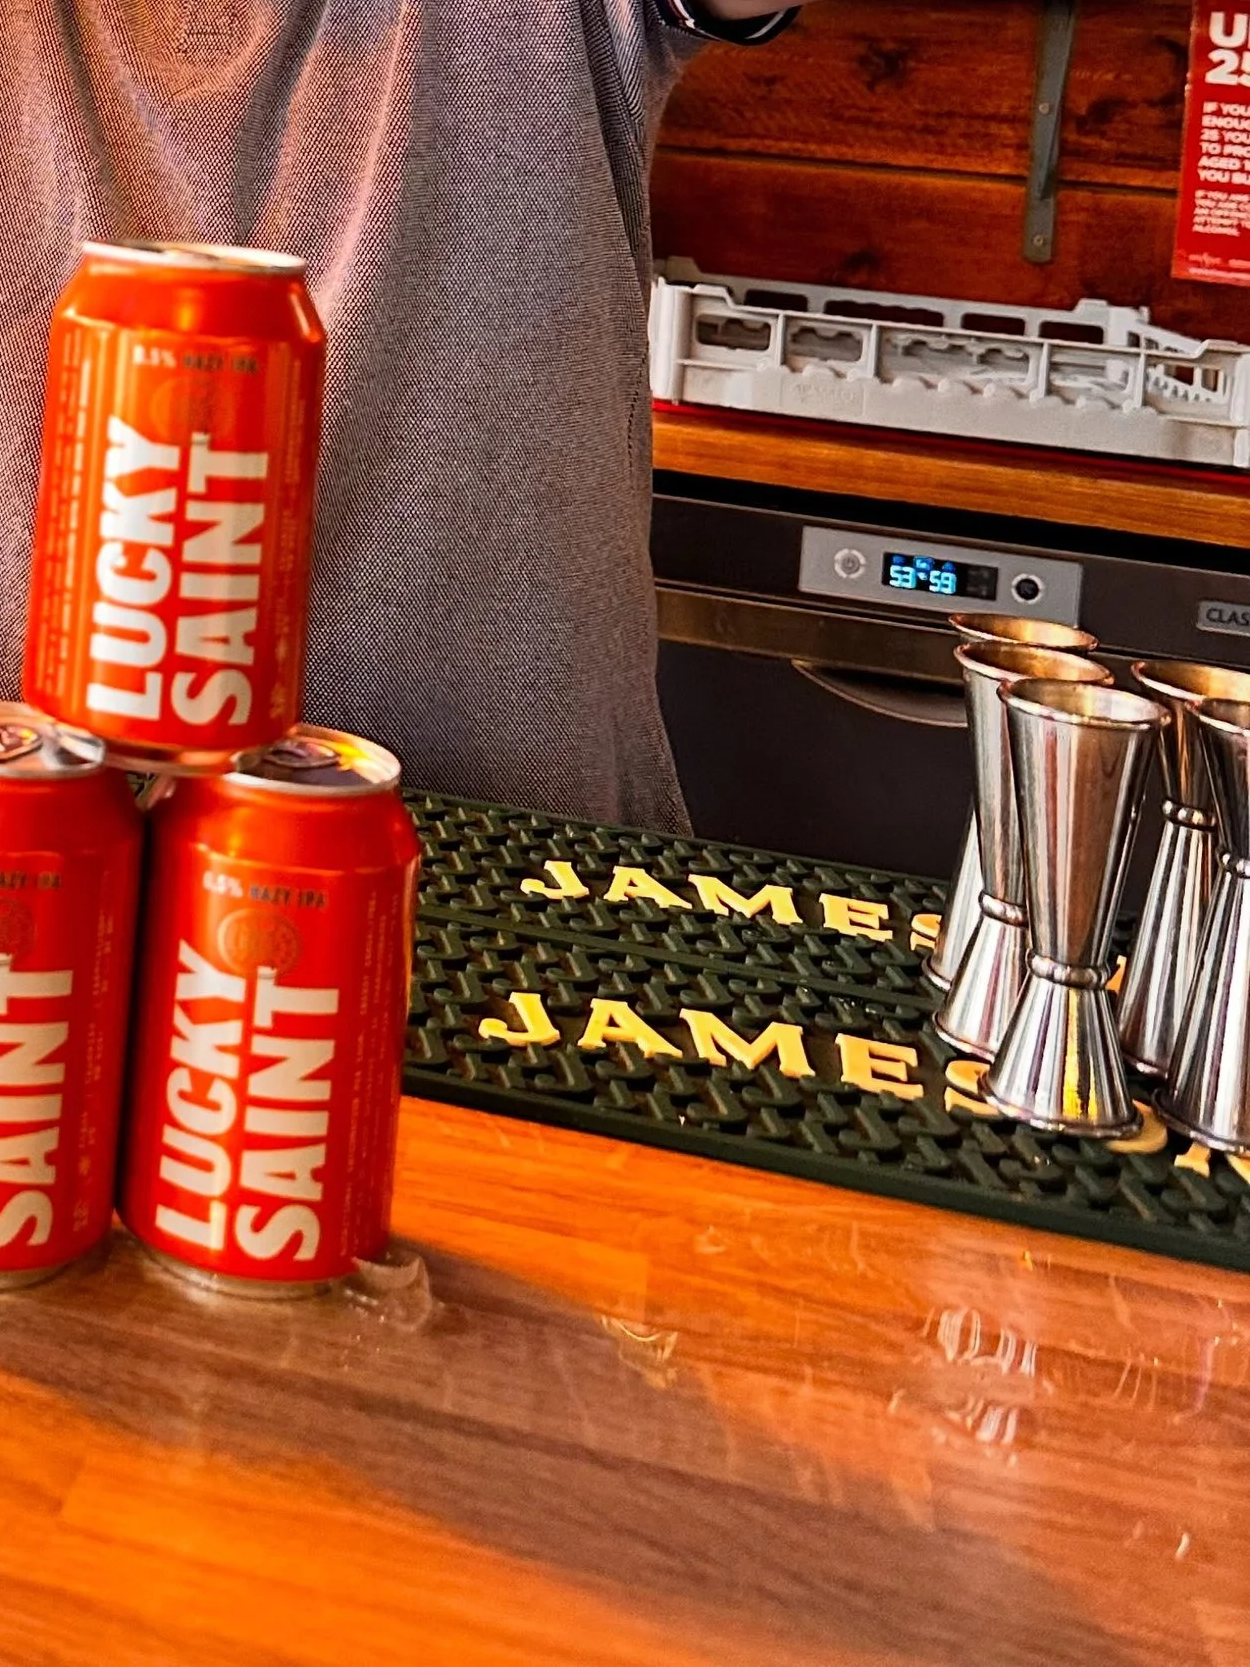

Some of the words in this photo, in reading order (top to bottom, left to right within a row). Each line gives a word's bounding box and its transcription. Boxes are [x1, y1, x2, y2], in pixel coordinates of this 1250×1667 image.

[1210, 12, 1250, 49] U
[86, 414, 181, 722] LUCKY
[171, 432, 269, 726] SAINT
[155, 940, 247, 1251] LUCKY
[235, 966, 339, 1262] SAINT
